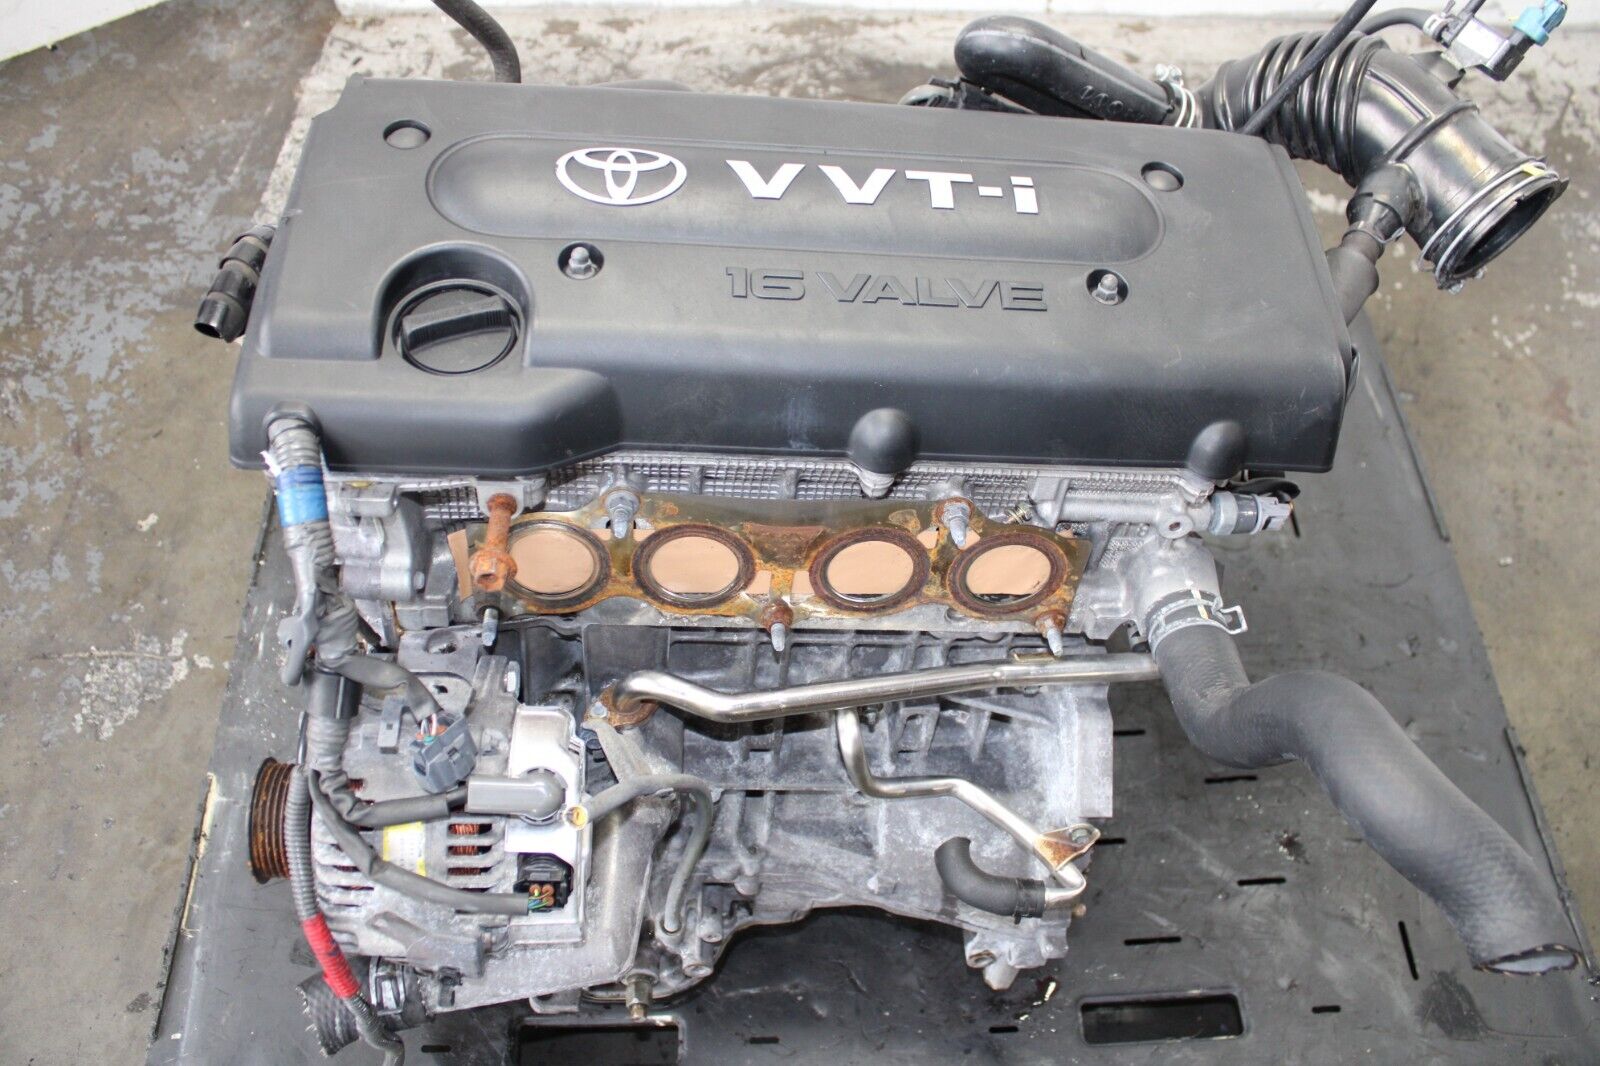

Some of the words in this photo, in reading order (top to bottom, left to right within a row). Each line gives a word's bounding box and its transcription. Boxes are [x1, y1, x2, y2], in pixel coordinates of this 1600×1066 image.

[726, 160, 1039, 214] VVT-i
[726, 266, 806, 301] 16
[816, 271, 1048, 312] VALVE
